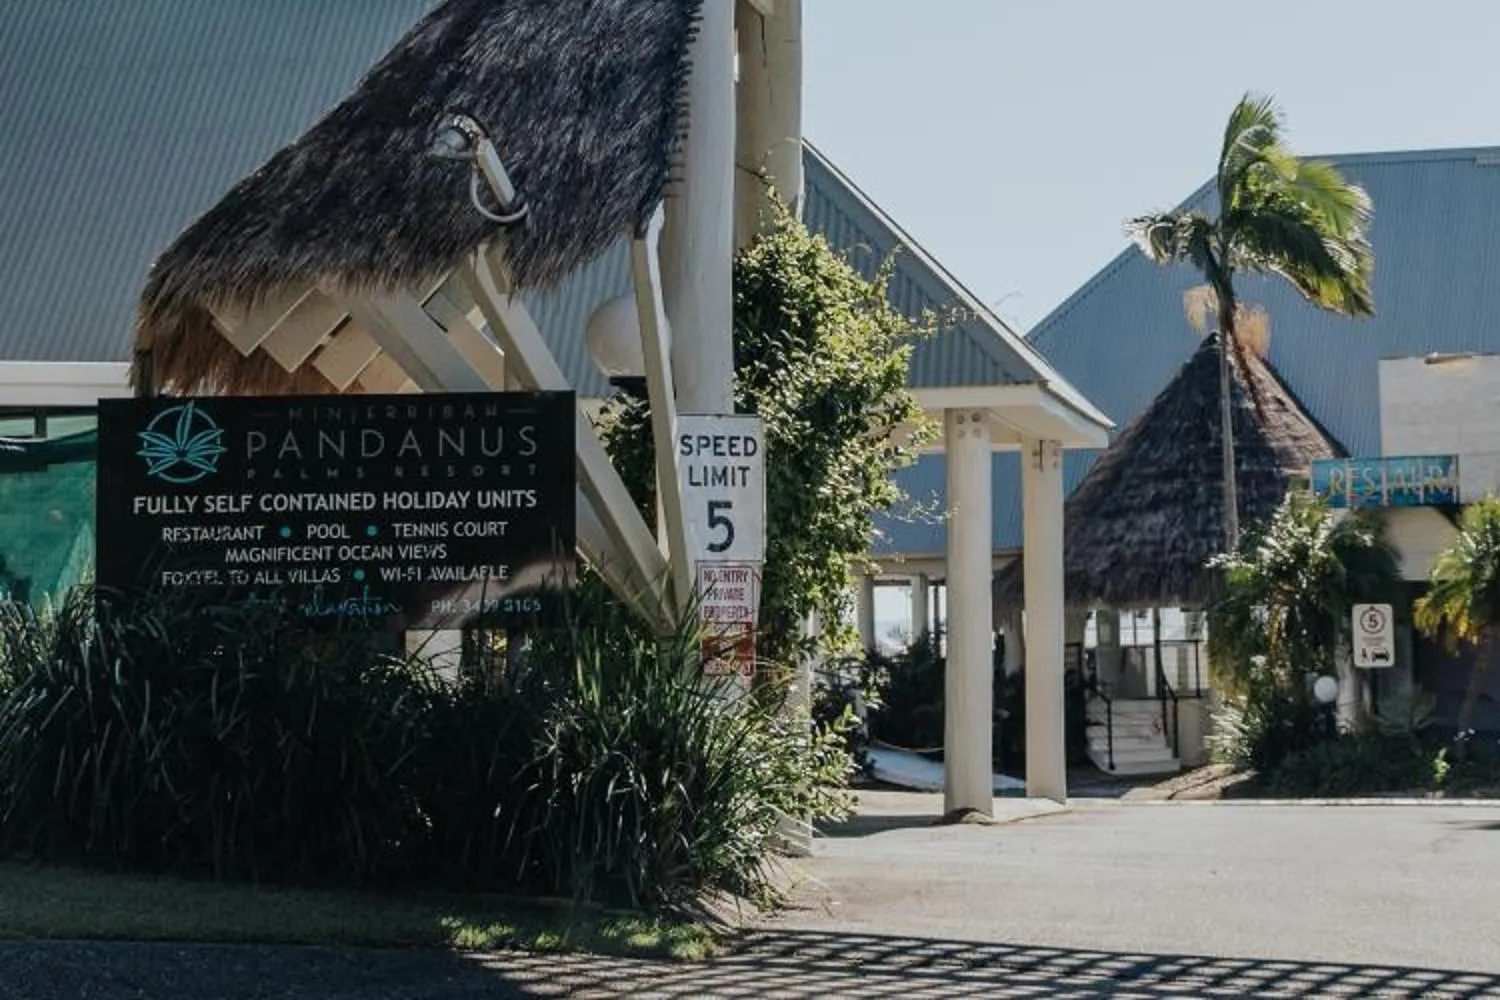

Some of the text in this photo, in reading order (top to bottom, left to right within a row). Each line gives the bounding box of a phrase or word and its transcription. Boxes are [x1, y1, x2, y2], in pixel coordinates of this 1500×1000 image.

[246, 425, 538, 460] PANDANUS
[679, 435, 757, 457] SPEED
[246, 463, 538, 480] PALMS RESORT
[688, 466, 751, 488] LIMIT
[132, 489, 538, 515] FULLY SELF CONTAINED HOLIDAY UNITS
[161, 520, 509, 543] RESTAURANT POOL TENNIS COURT
[706, 500, 736, 553] 5
[224, 543, 448, 564] MAGNIFICENT OCEAN VIEWS
[229, 569, 249, 586] TO
[253, 568, 284, 585] ALL
[287, 566, 342, 584] VILLAS
[1368, 613, 1379, 629] 5
